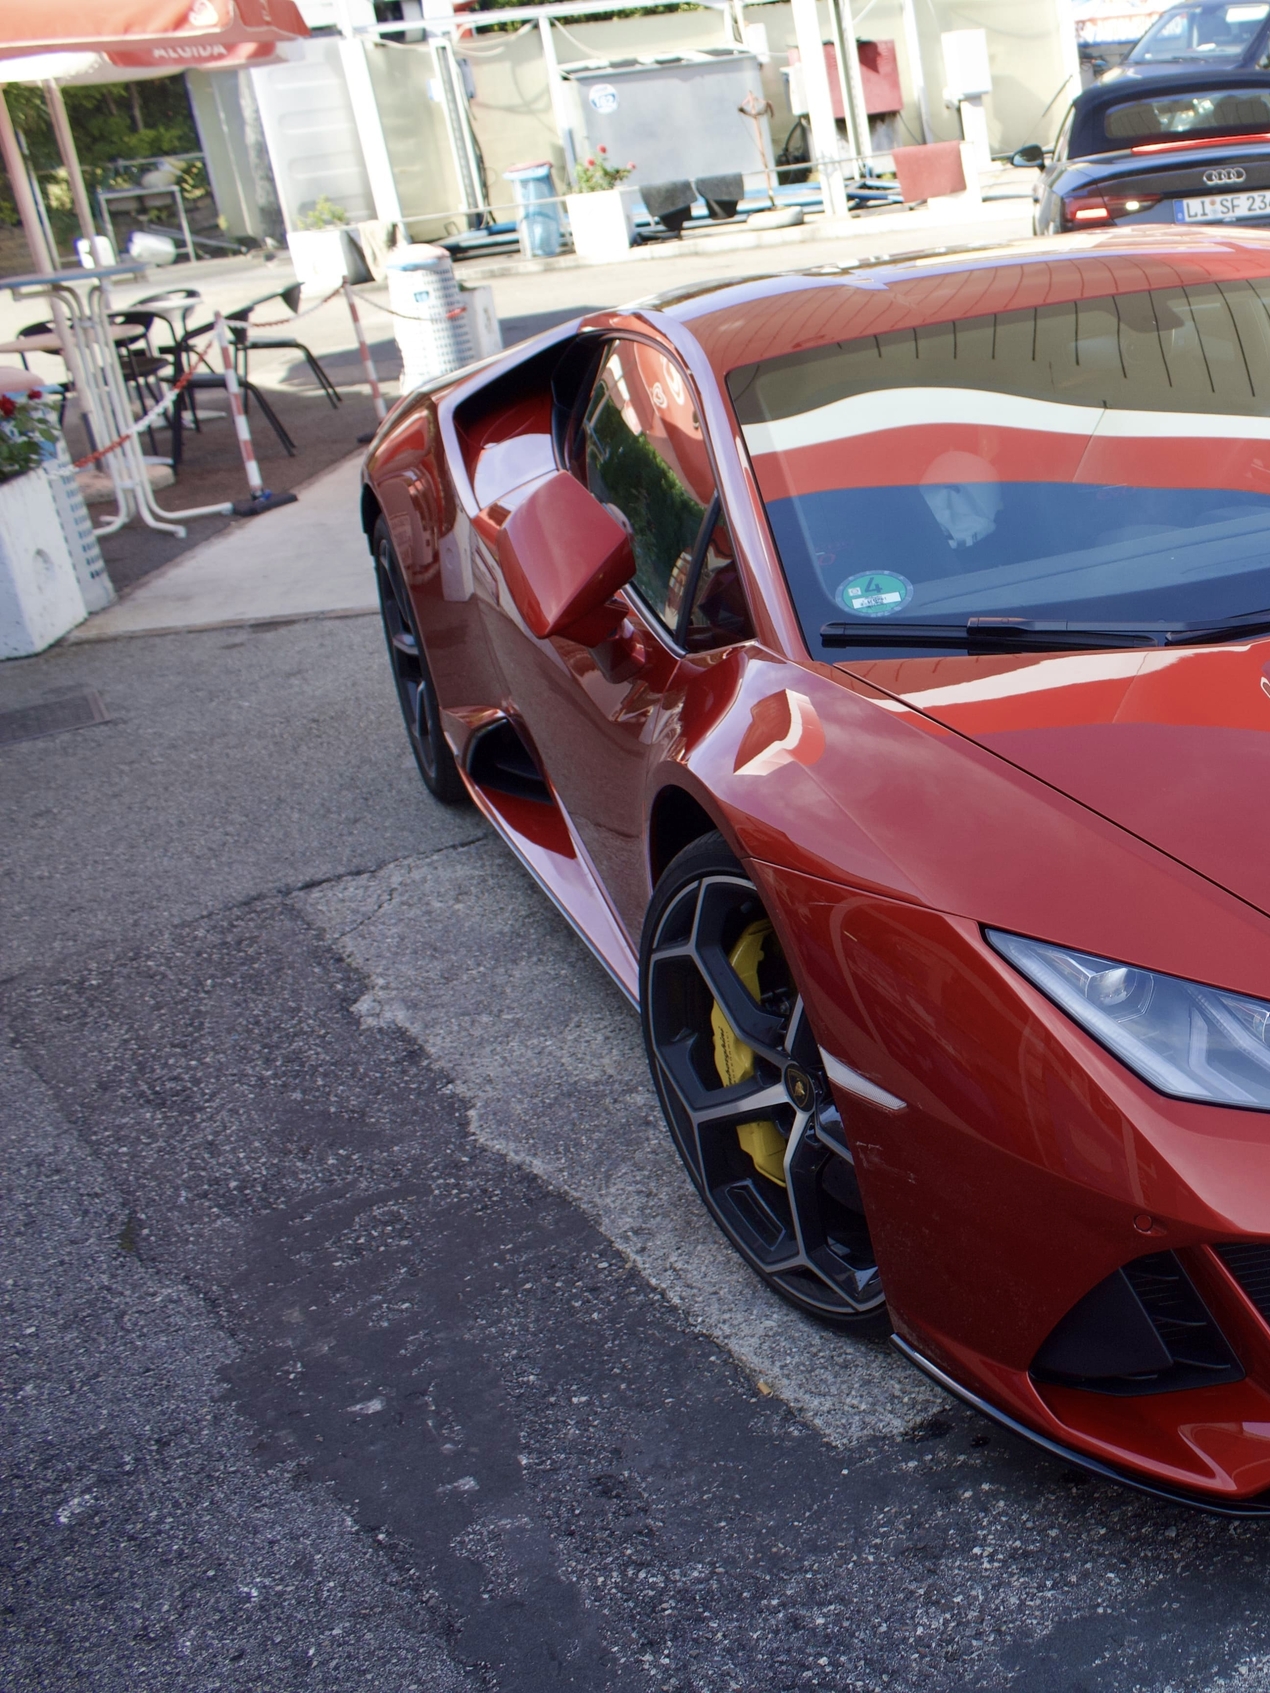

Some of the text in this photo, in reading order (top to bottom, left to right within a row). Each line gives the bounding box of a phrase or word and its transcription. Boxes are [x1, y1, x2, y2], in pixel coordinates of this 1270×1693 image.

[1186, 201, 1209, 218] LI
[1220, 196, 1241, 215] SF
[865, 577, 883, 594] 4
